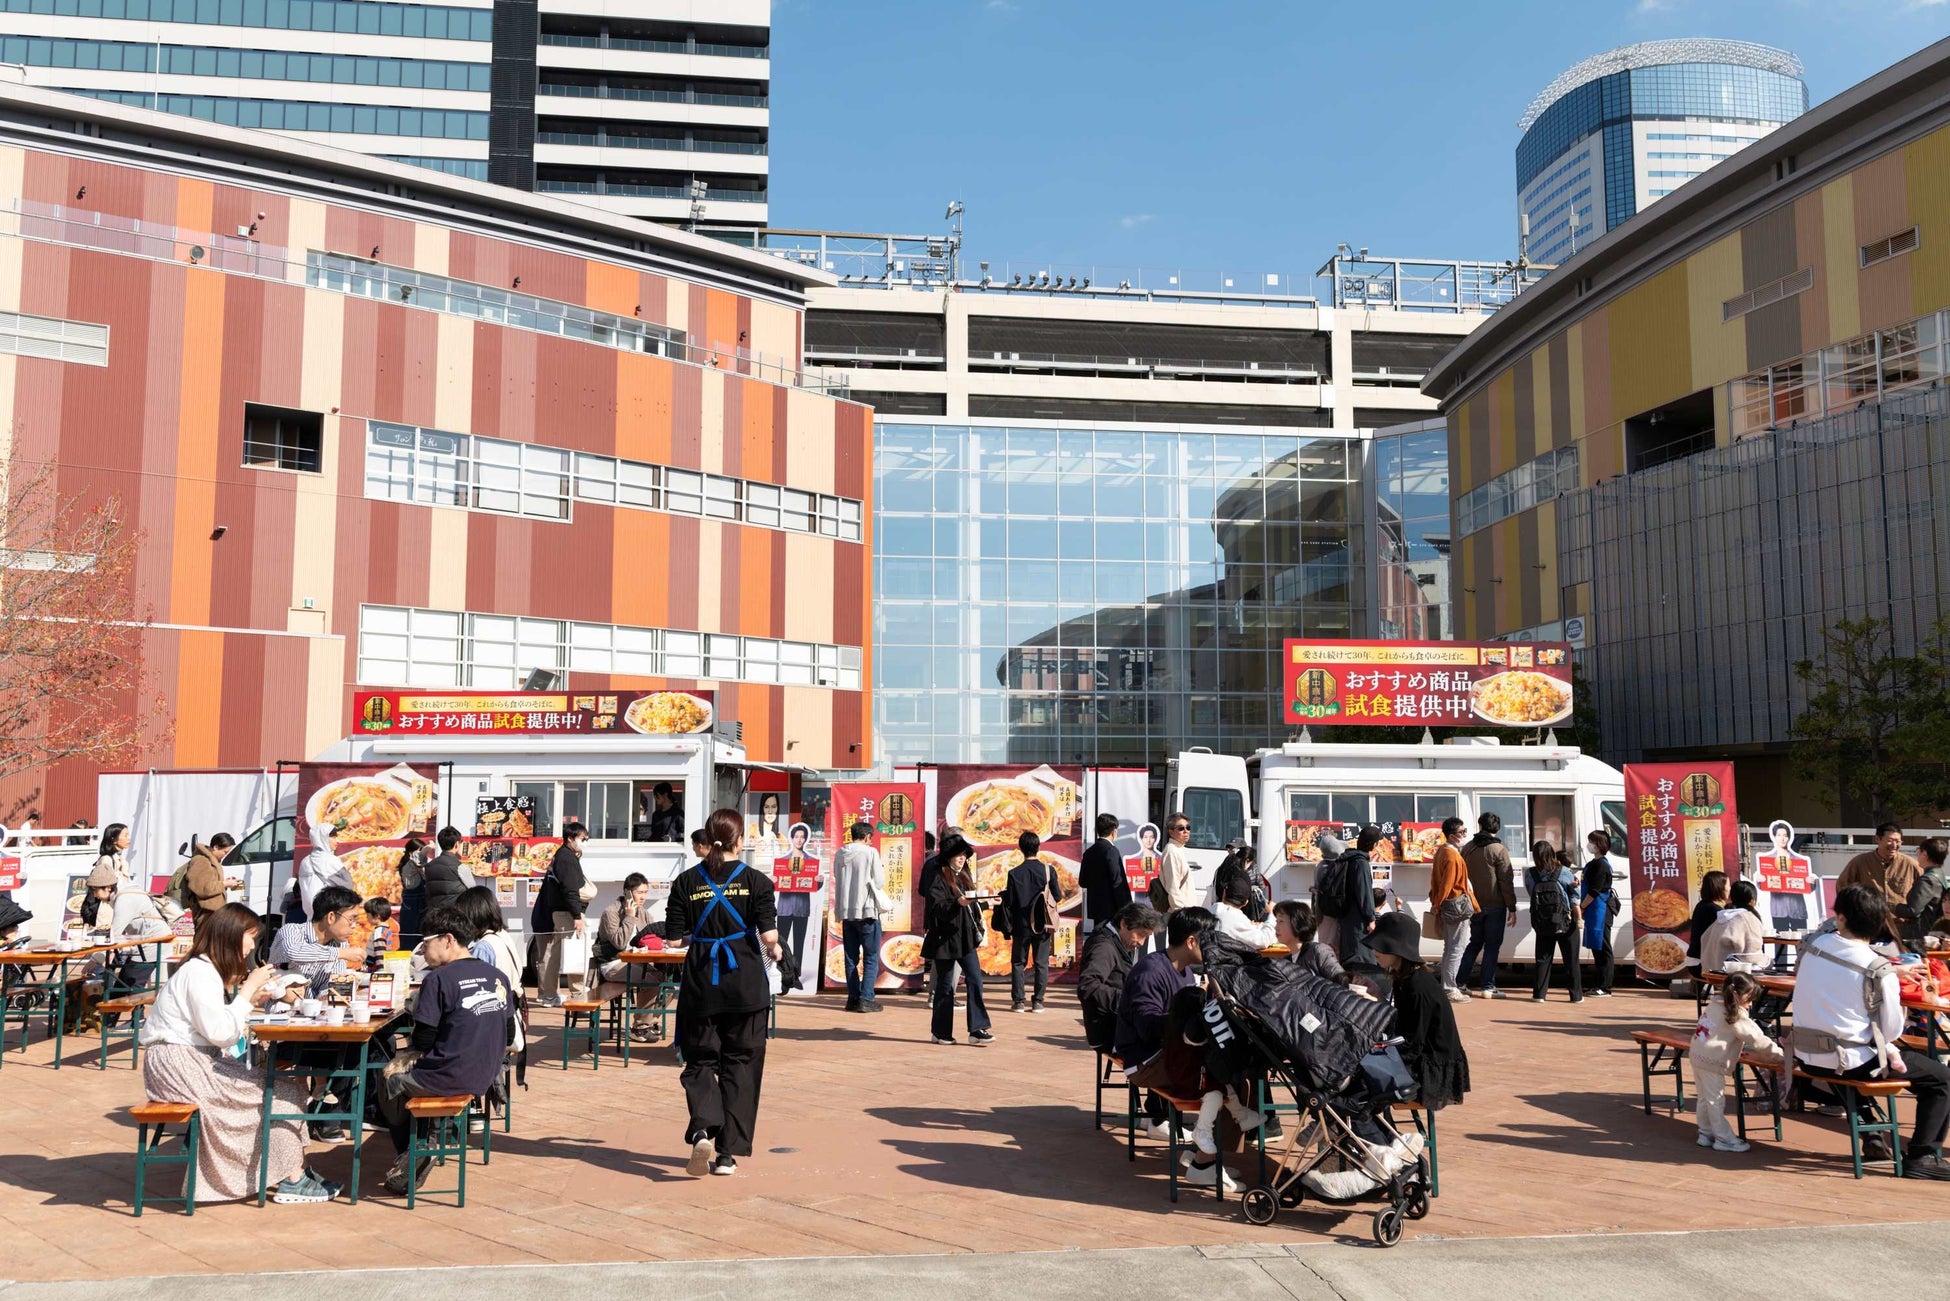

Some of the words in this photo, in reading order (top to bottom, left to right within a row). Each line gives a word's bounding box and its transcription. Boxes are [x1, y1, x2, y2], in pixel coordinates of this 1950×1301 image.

[1344, 669, 1473, 693] おすすめ商品
[1344, 693, 1476, 719] 試食提供中!
[397, 711, 583, 731] おすすめ商品試食提供中!
[1657, 777, 1680, 878] おすすめ商品
[1639, 794, 1660, 895] 試食提供中!
